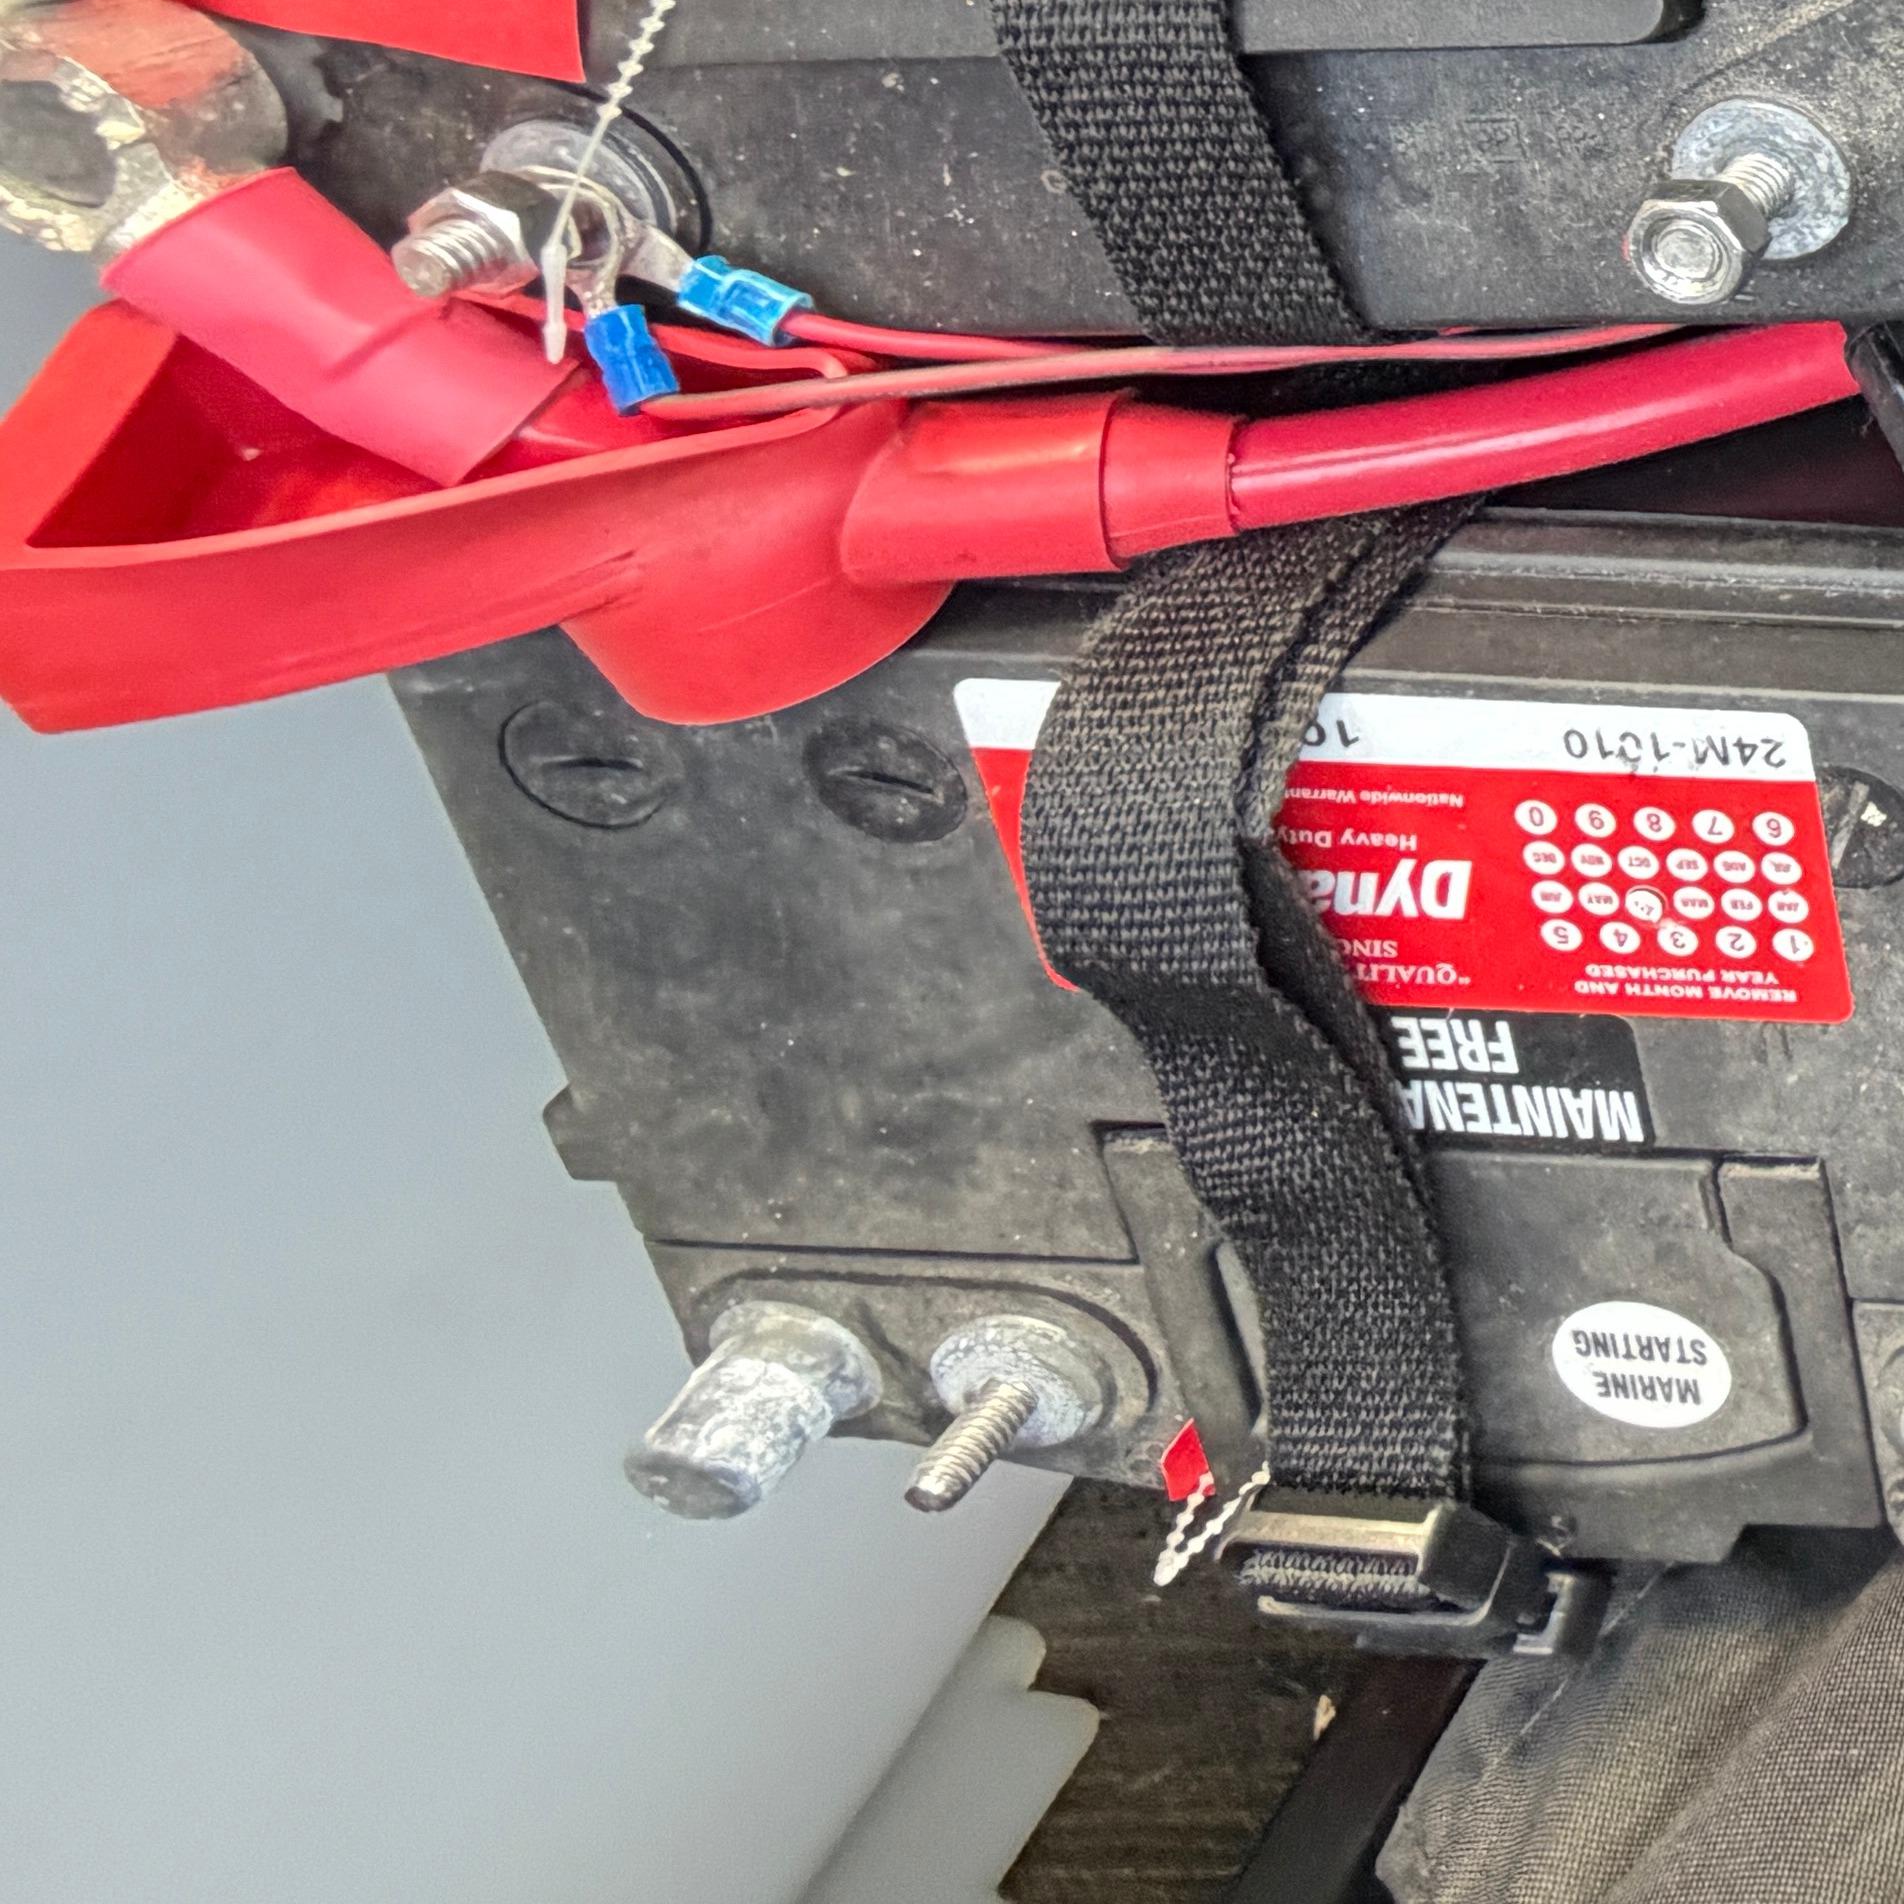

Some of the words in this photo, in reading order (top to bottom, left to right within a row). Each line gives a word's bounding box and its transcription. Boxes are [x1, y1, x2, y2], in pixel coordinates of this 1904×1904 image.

[1360, 791, 1464, 807] Nationwide
[1528, 806, 1544, 826] 0
[1588, 810, 1604, 830] 9
[1646, 813, 1662, 833] 8
[1707, 816, 1723, 835] 7
[1766, 818, 1781, 837] 6
[1339, 827, 1417, 851] Heavy
[1296, 858, 1473, 920] Dyna
[1553, 926, 1569, 945] 5
[1613, 928, 1628, 948] 4
[1670, 930, 1686, 949] 3
[1727, 932, 1745, 952] 2
[1789, 935, 1800, 954] 1
[1585, 963, 1715, 983] PURCHASED
[1720, 969, 1779, 985] YEAR
[1574, 980, 1619, 996] AND
[1625, 982, 1702, 999] MONTH
[1708, 985, 1797, 1002] REMOVE
[1391, 1016, 1519, 1074] FREE
[1399, 1079, 1644, 1143] MAINTENA
[1571, 1330, 1708, 1366] STARTING
[1592, 1371, 1701, 1405] MARINE
